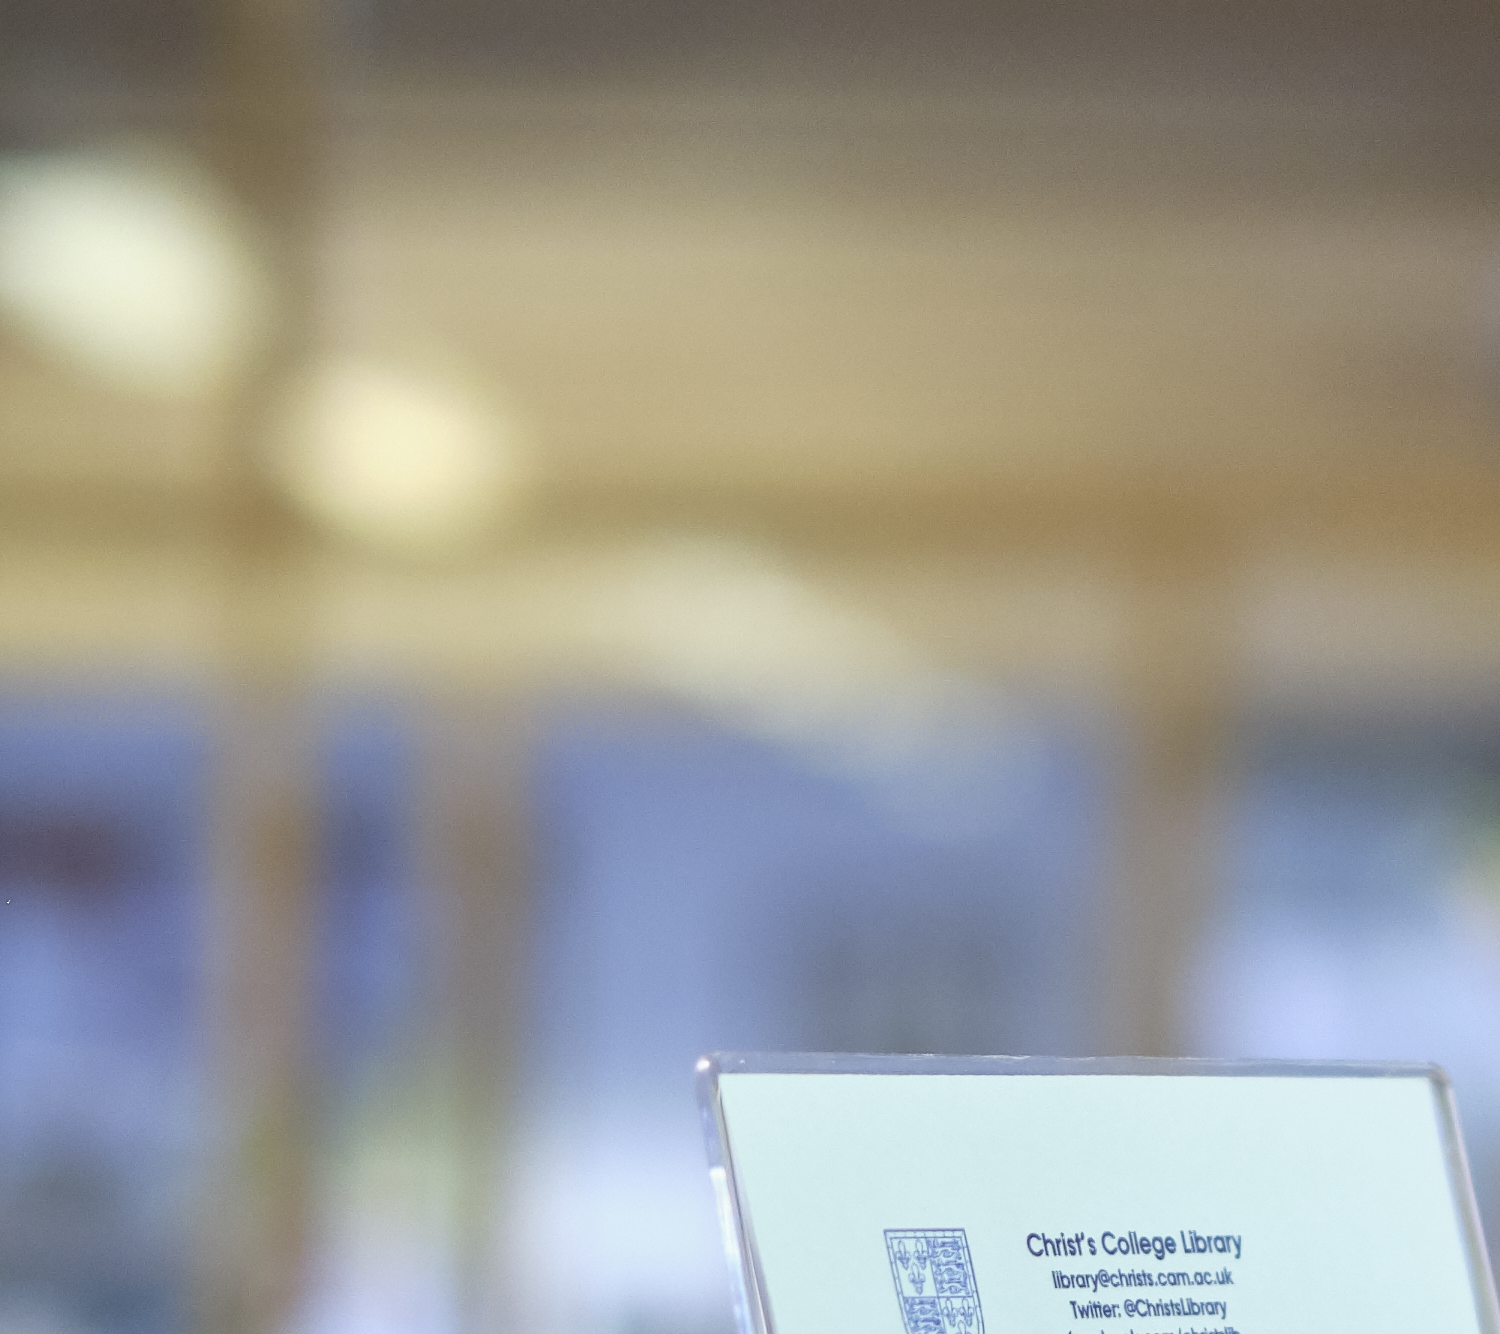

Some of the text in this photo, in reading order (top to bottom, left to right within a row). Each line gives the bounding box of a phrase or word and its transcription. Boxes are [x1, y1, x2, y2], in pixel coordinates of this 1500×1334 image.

[1026, 1230, 1242, 1260] Christ's College Library
[1051, 1266, 1234, 1293] library@christs.cam.ac.uk
[1069, 1297, 1228, 1320] Twitter: @ChristsLibrary
